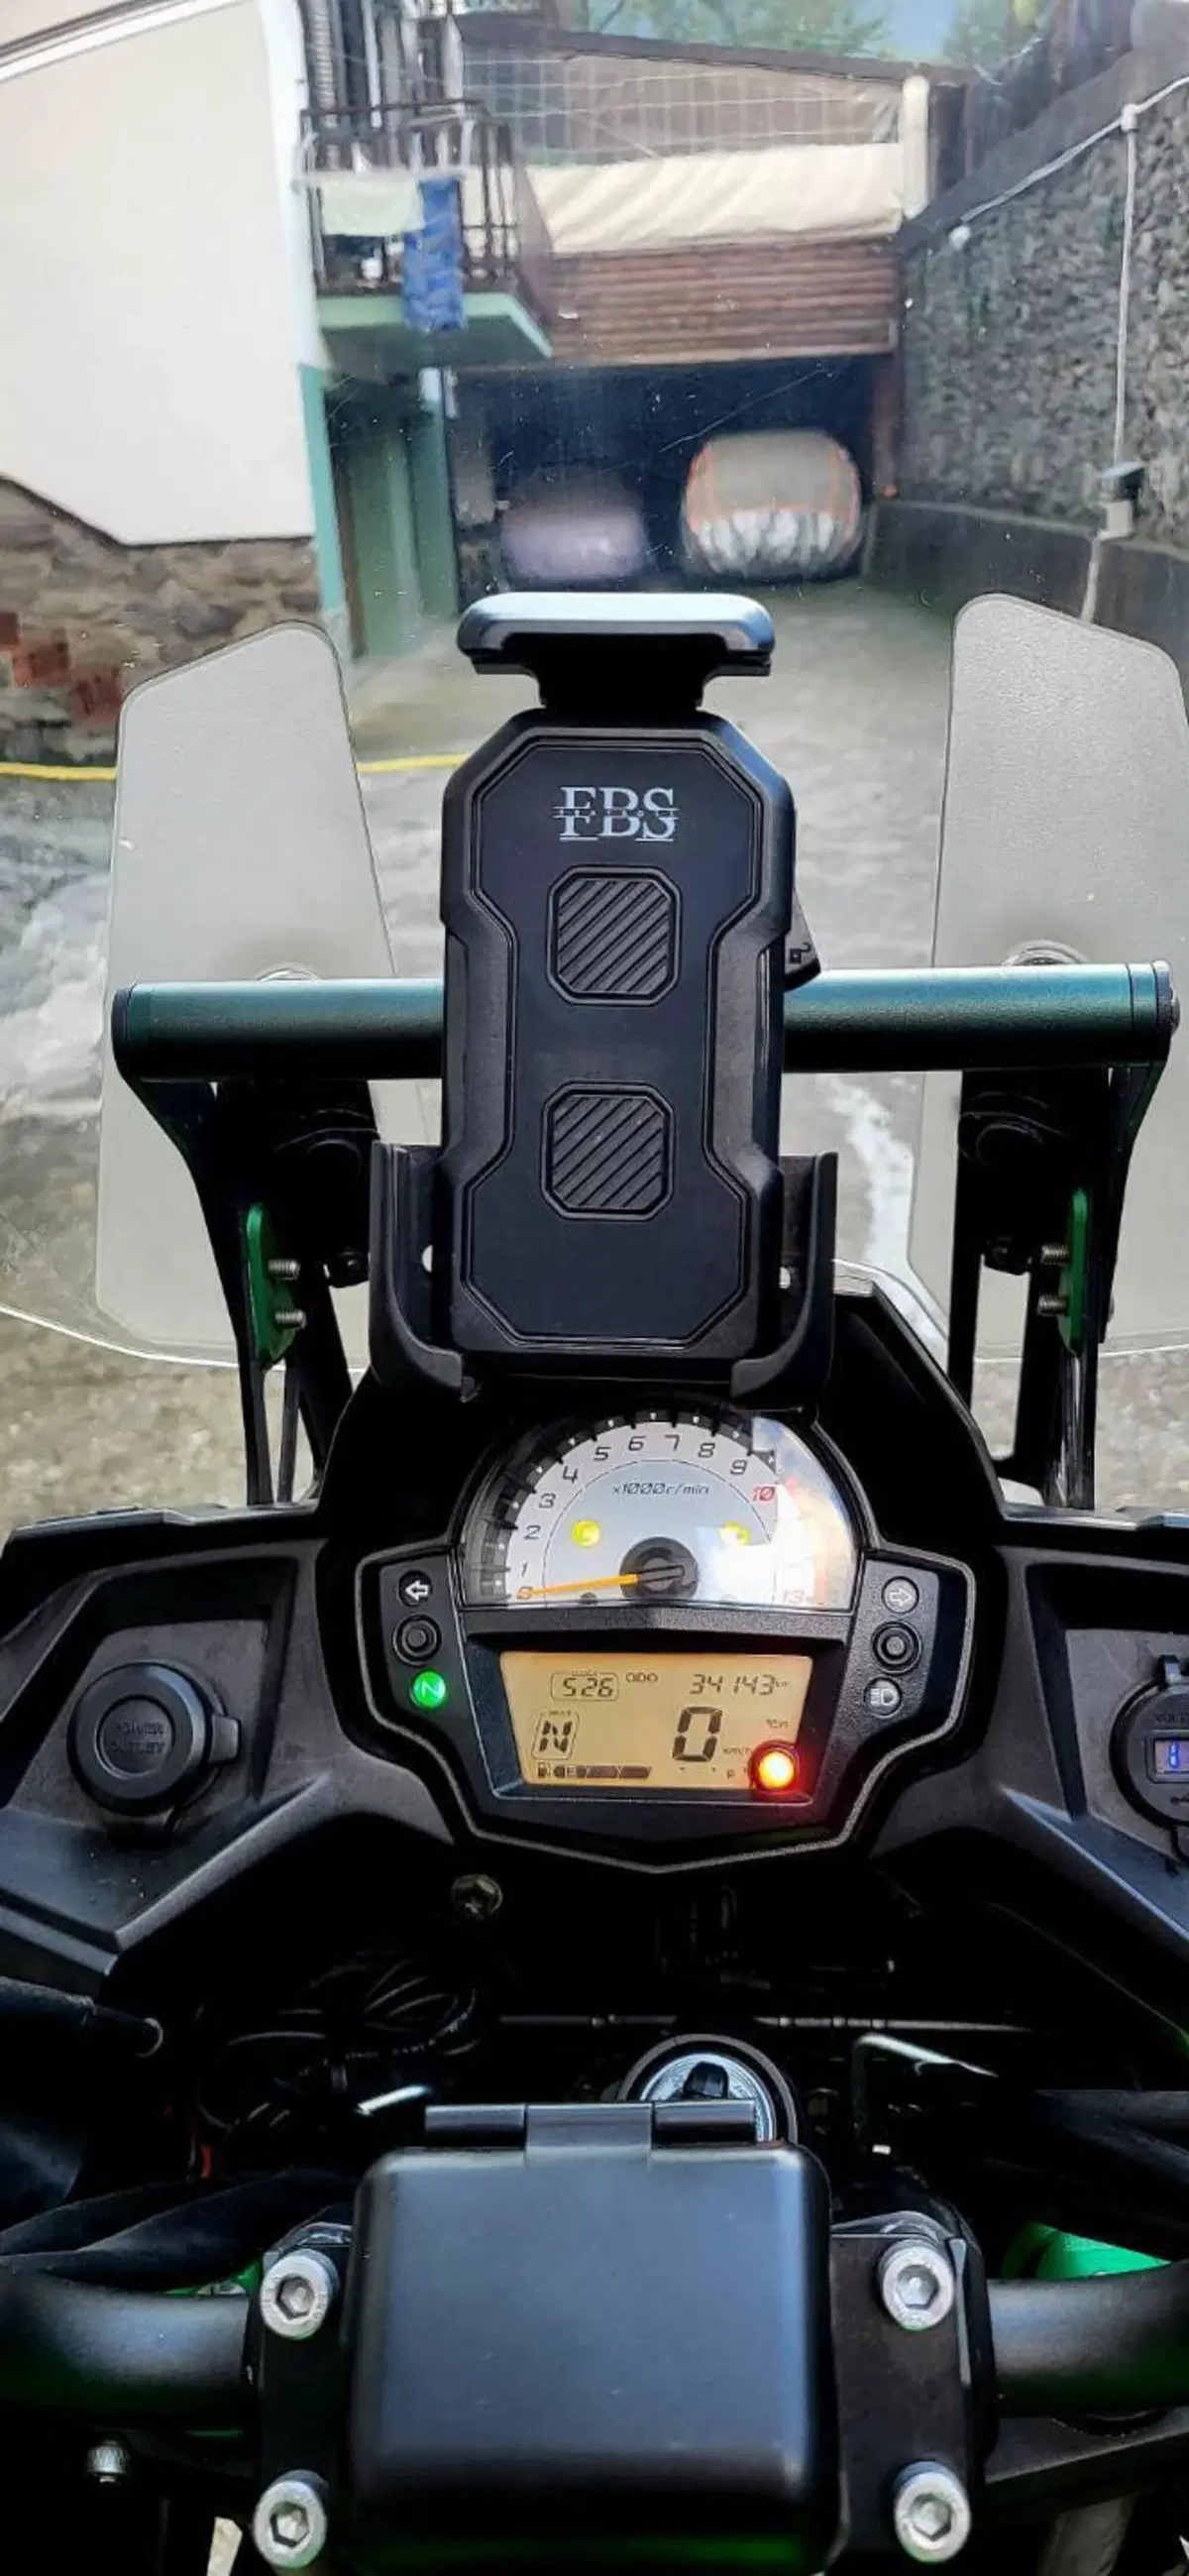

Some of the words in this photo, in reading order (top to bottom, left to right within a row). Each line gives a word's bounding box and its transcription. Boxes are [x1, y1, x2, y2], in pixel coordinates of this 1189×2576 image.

[553, 786, 678, 840] FBS
[627, 1435, 646, 1452] 6
[664, 1433, 681, 1451] 7
[698, 1441, 716, 1458] 8
[593, 1446, 611, 1462] 5
[562, 1466, 579, 1484] 4
[729, 1459, 748, 1475] 9
[538, 1493, 556, 1510] 3
[752, 1486, 776, 1502] 10
[523, 1524, 541, 1540] 2
[520, 1561, 529, 1579] 1
[421, 1680, 445, 1699] N
[689, 1673, 776, 1696] 34143
[538, 1720, 574, 1753] N
[672, 1706, 723, 1762] 0
